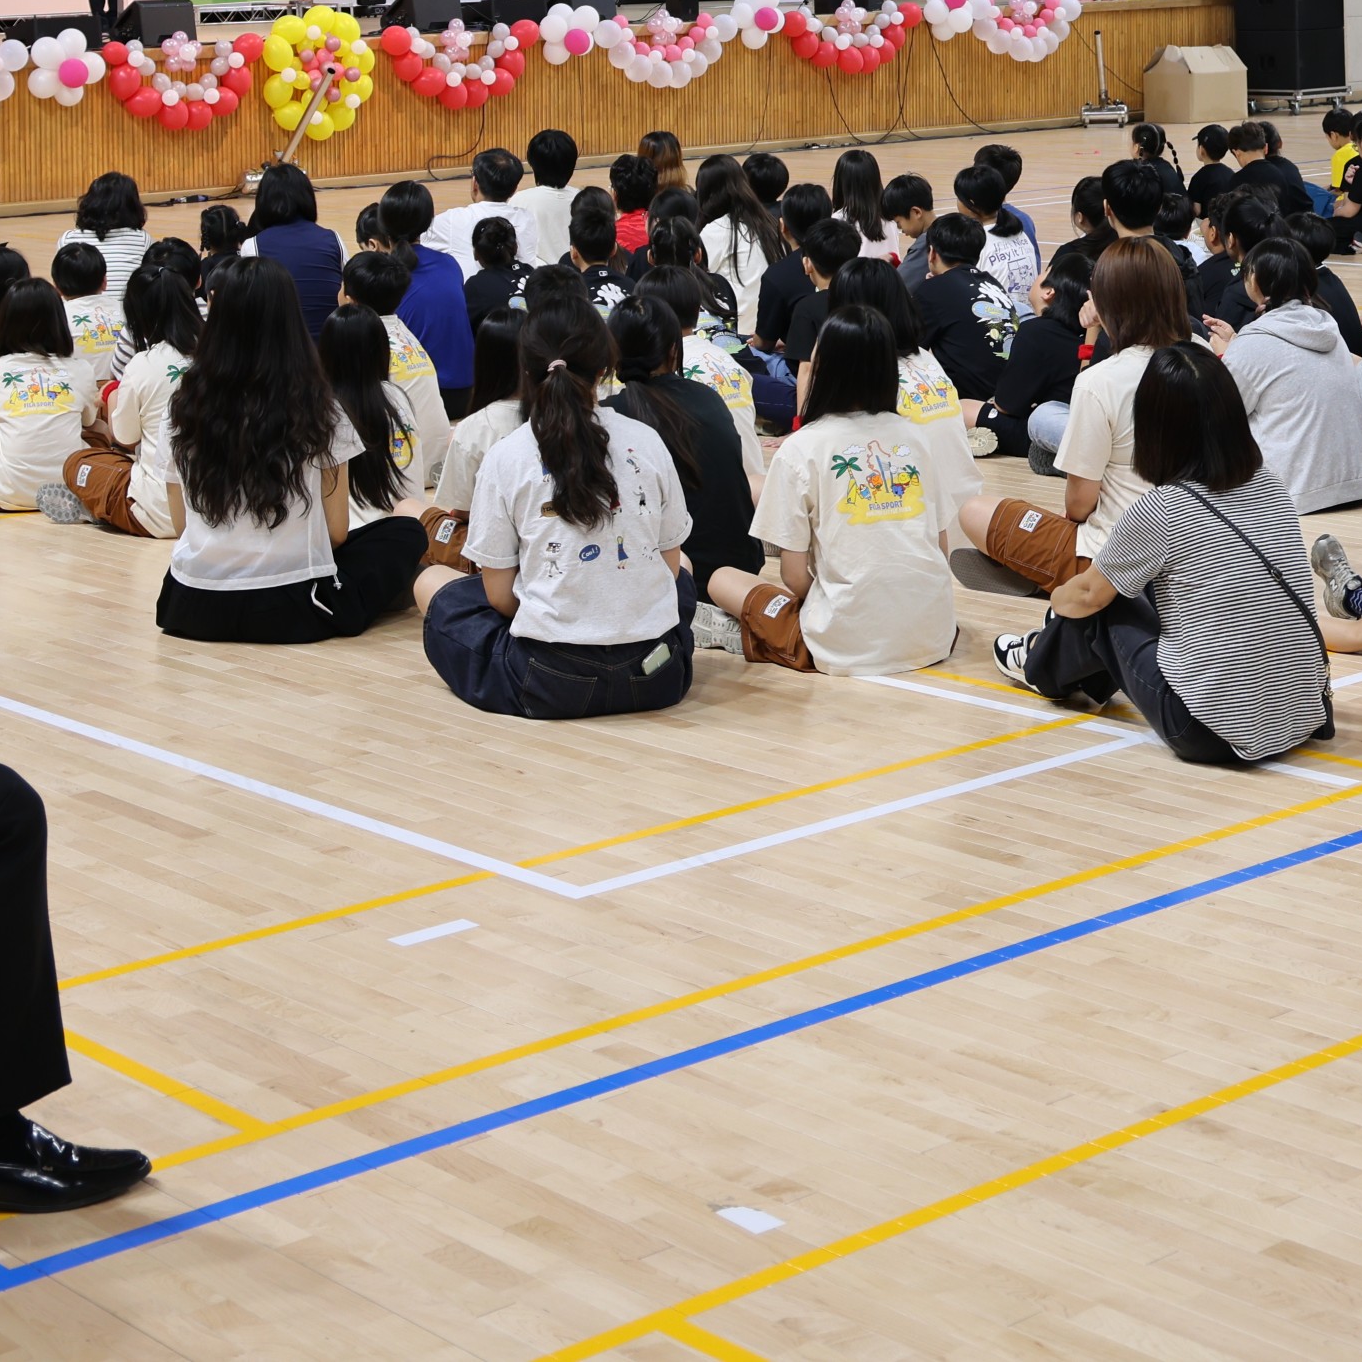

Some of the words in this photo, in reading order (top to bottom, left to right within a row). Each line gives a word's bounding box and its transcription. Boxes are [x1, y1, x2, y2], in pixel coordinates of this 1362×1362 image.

[1013, 238, 1029, 247] Nice
[989, 250, 1011, 266] Play
[869, 503, 881, 511] FILA
[880, 500, 903, 510] SPORT
[581, 545, 600, 560] Cool!
